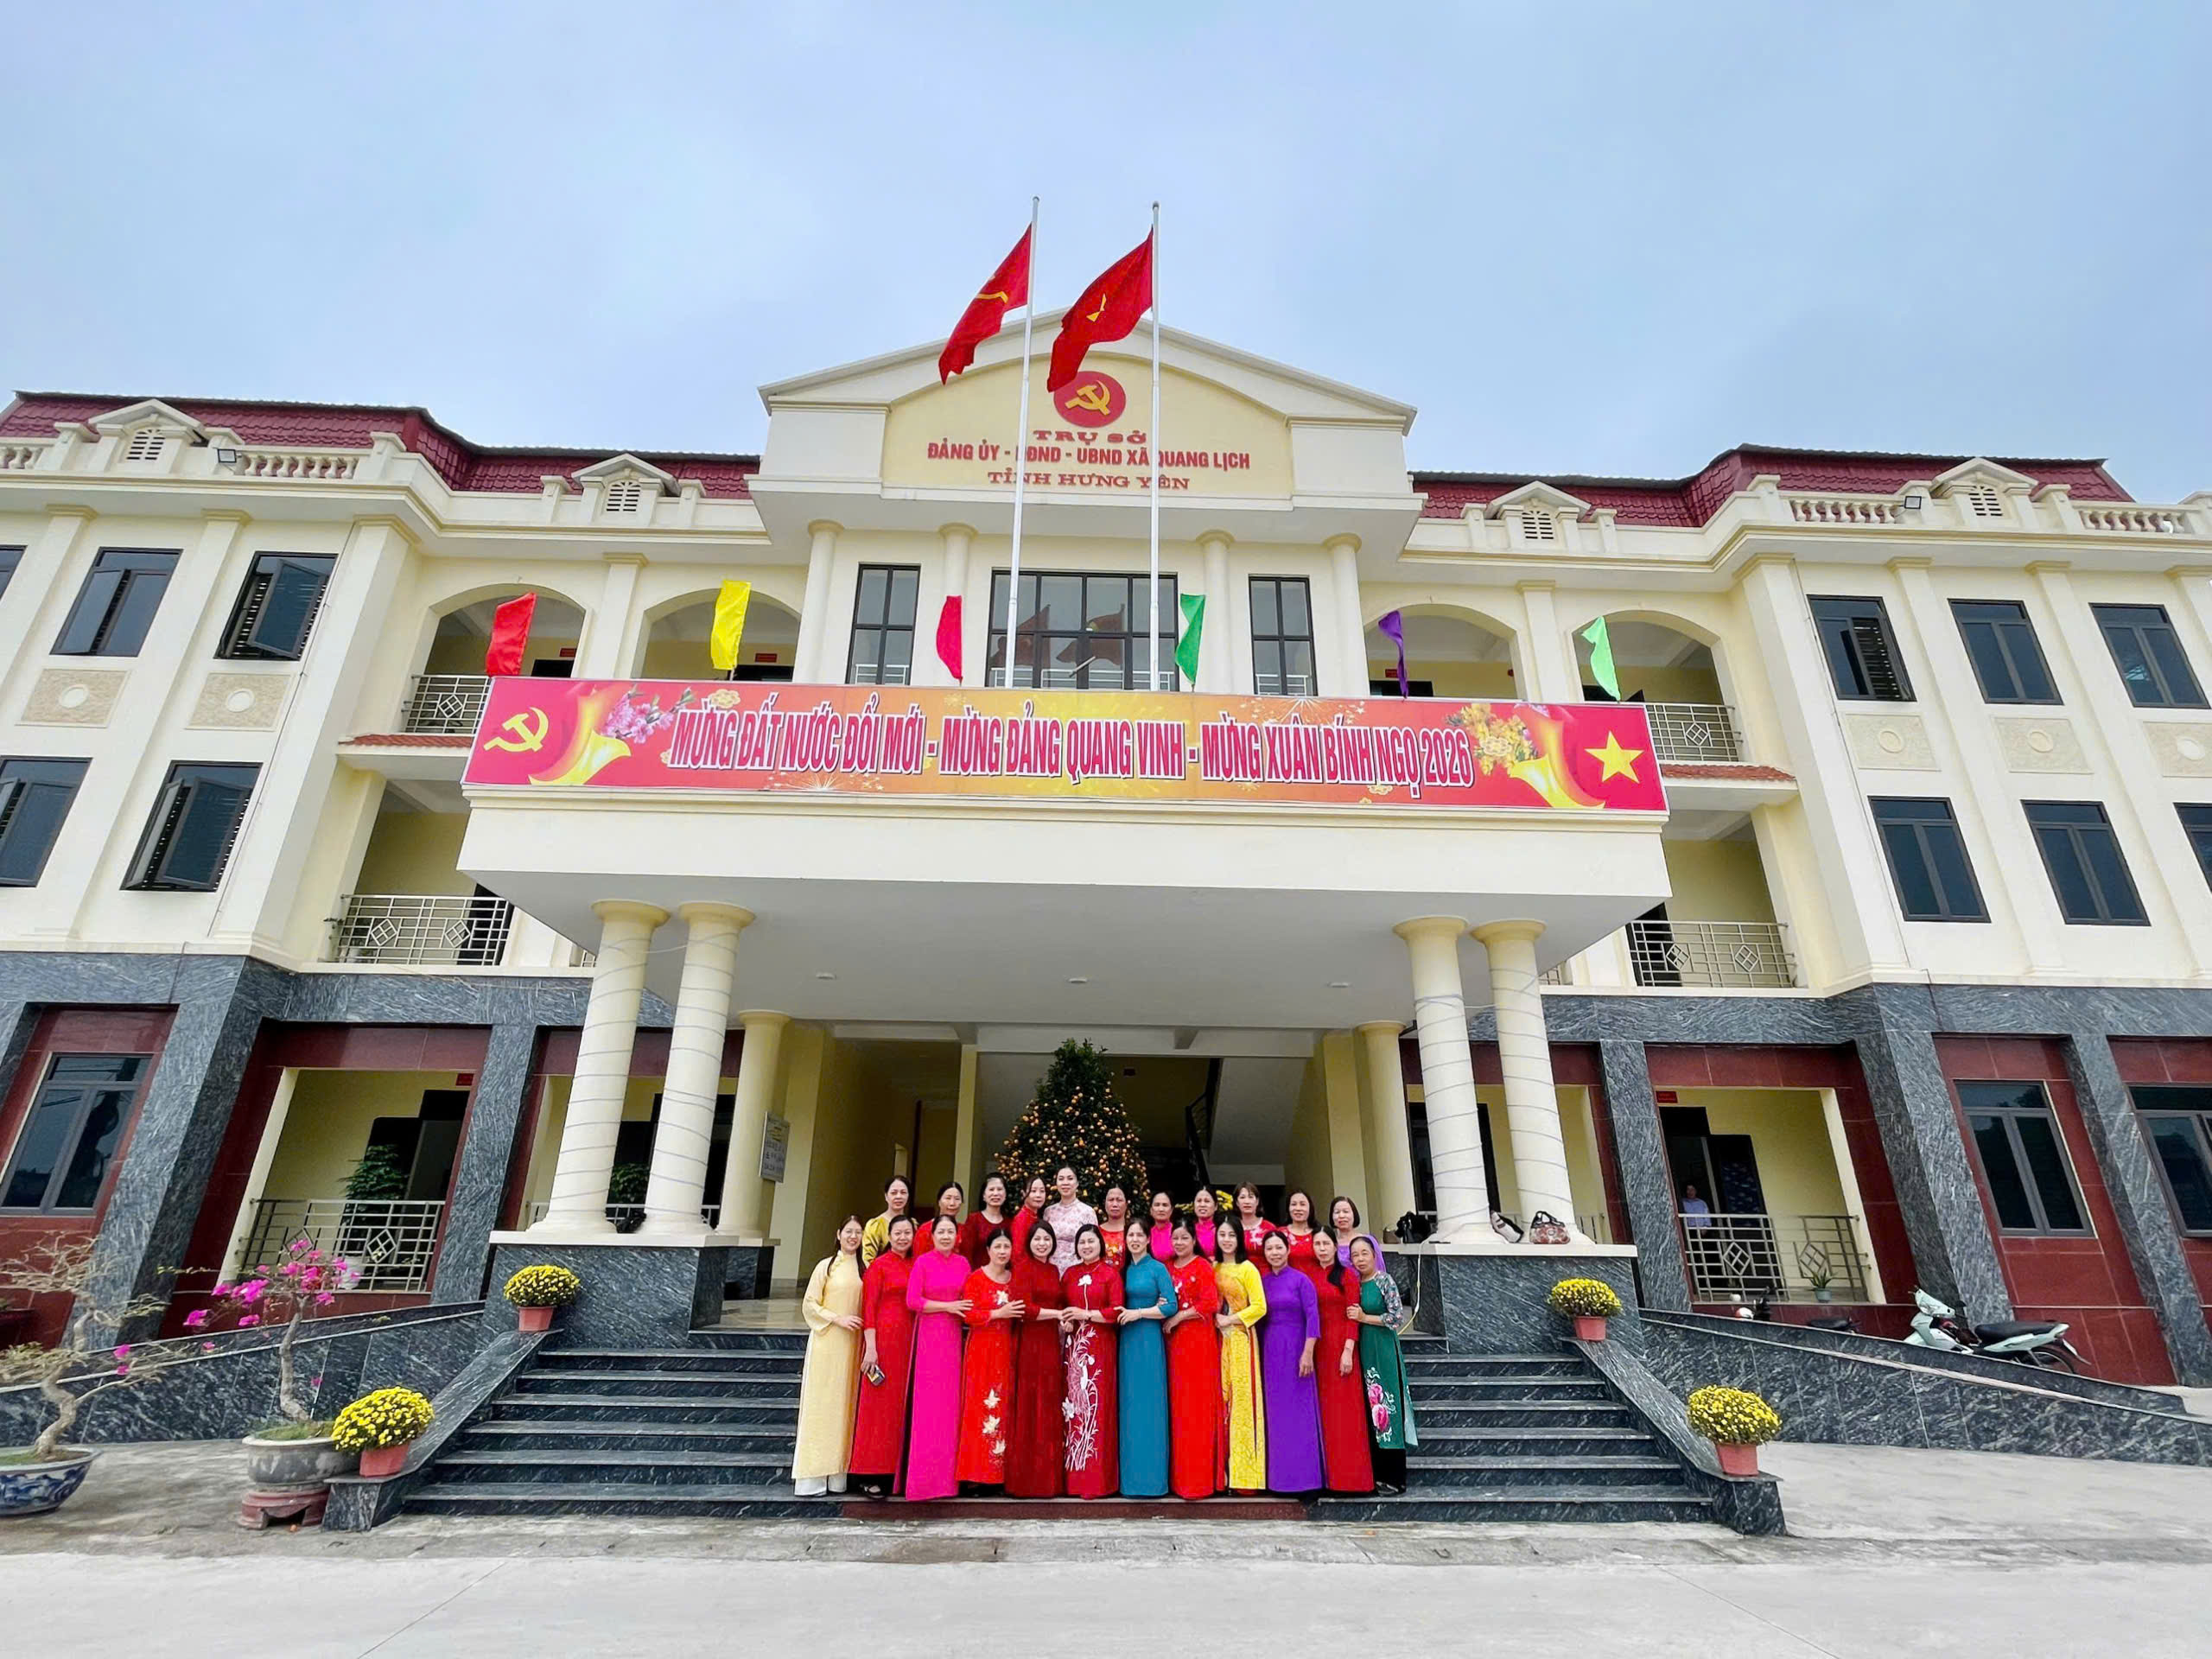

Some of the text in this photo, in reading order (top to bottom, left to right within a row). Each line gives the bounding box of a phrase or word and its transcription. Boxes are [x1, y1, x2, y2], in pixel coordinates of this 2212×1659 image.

[1033, 430, 1147, 445] TRỤ SỞ
[927, 437, 974, 460] ĐẢNG
[978, 439, 1001, 461] ỦY
[1077, 448, 1122, 465] UBND
[1127, 447, 1149, 466] XÃ
[1213, 452, 1250, 471] LỊCH
[988, 467, 1190, 490] TỈNH HƯNG YÊN
[669, 698, 739, 768] MỪNG
[735, 692, 785, 770] ĐẤT
[779, 701, 842, 772] NƯỚC
[840, 691, 881, 773] ĐỔI
[880, 703, 926, 774] MỚI
[939, 704, 1003, 776] MỪNG
[1005, 699, 1063, 777] ĐẢNG
[1064, 719, 1134, 785] QUANG
[1135, 720, 1185, 779] VINH
[1199, 710, 1263, 782] MỪNG
[1263, 713, 1323, 783] XUÂN
[1321, 714, 1376, 785] BÍNH
[1373, 727, 1421, 799] NGỌ
[1419, 728, 1474, 787] 2026
